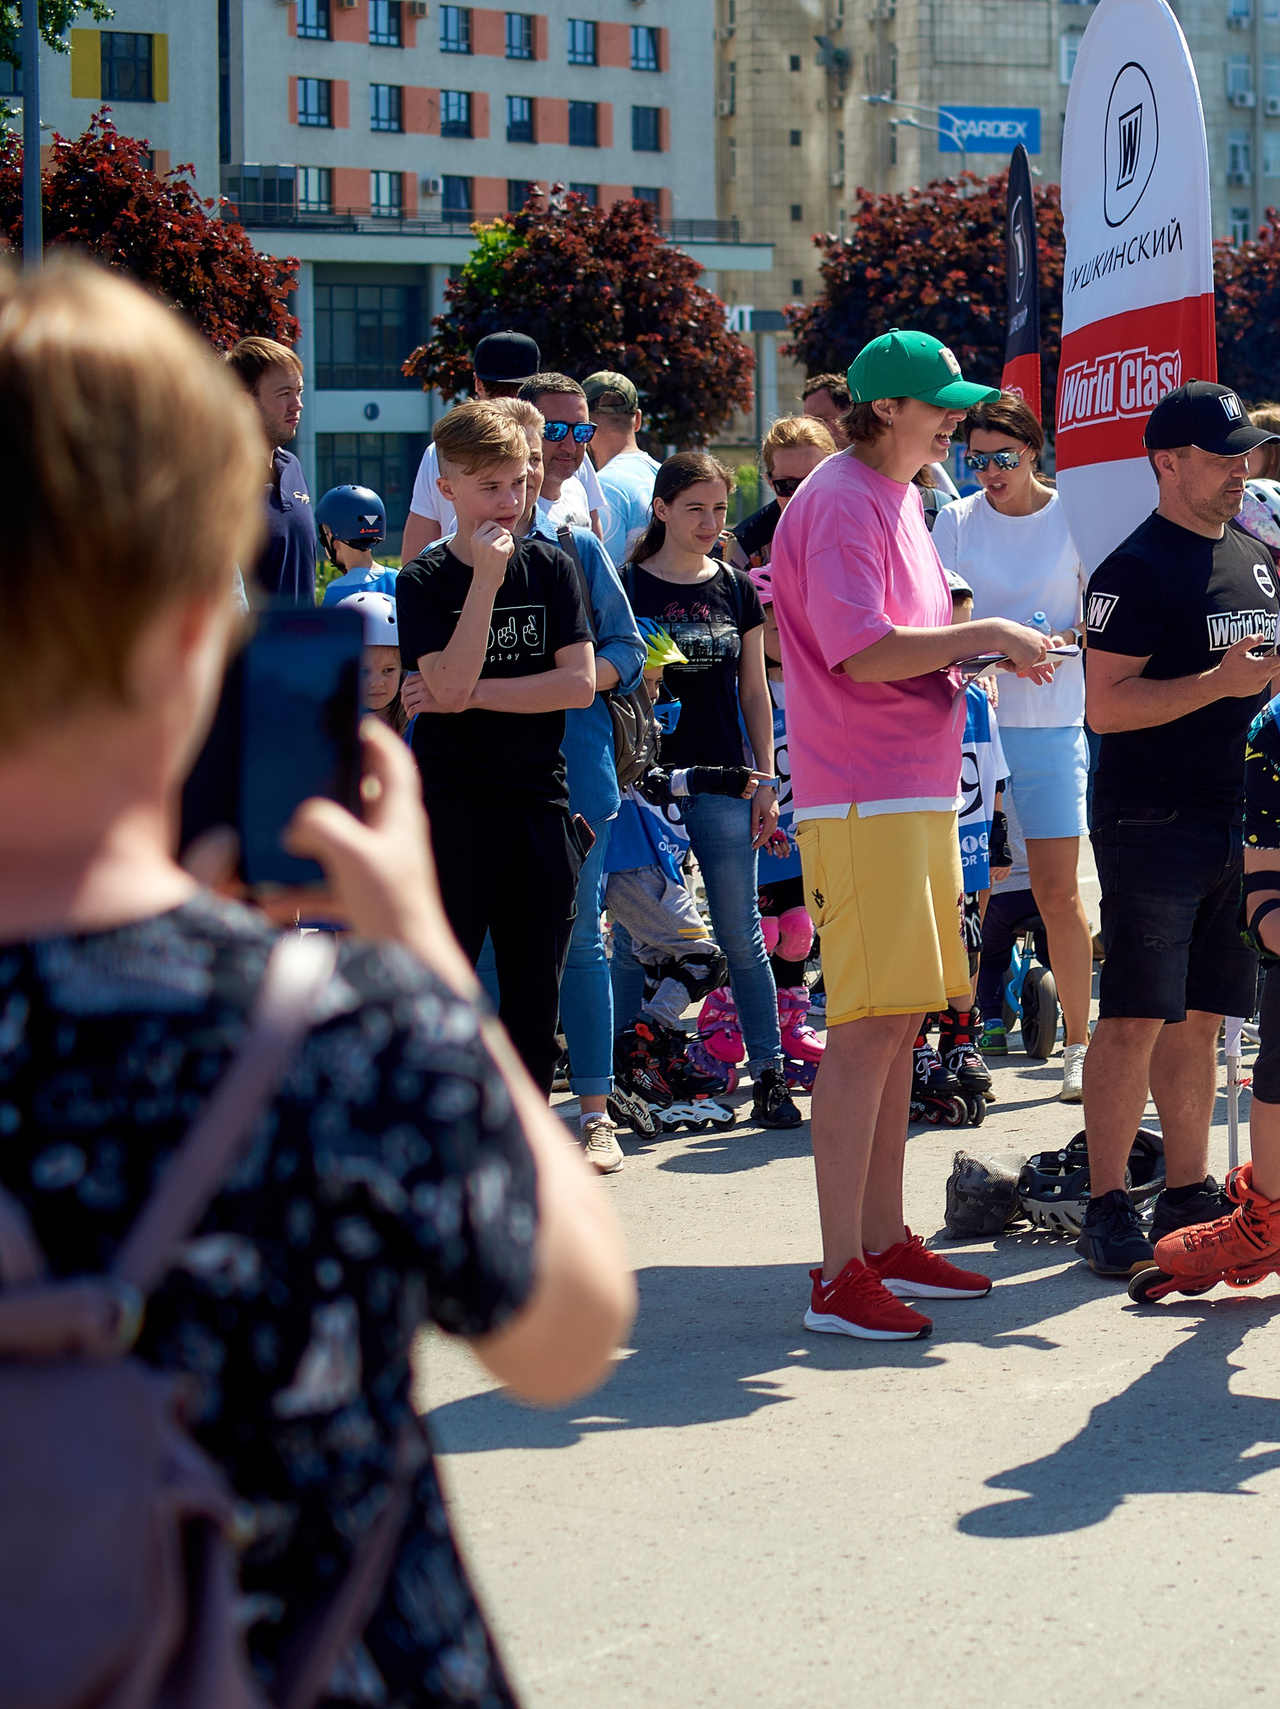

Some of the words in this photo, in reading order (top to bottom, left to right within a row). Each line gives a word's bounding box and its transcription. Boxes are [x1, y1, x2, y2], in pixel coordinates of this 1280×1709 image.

[952, 119, 1028, 139] CARDEX
[1060, 361, 1116, 424] World
[1222, 396, 1240, 418] W
[1088, 596, 1112, 627] W
